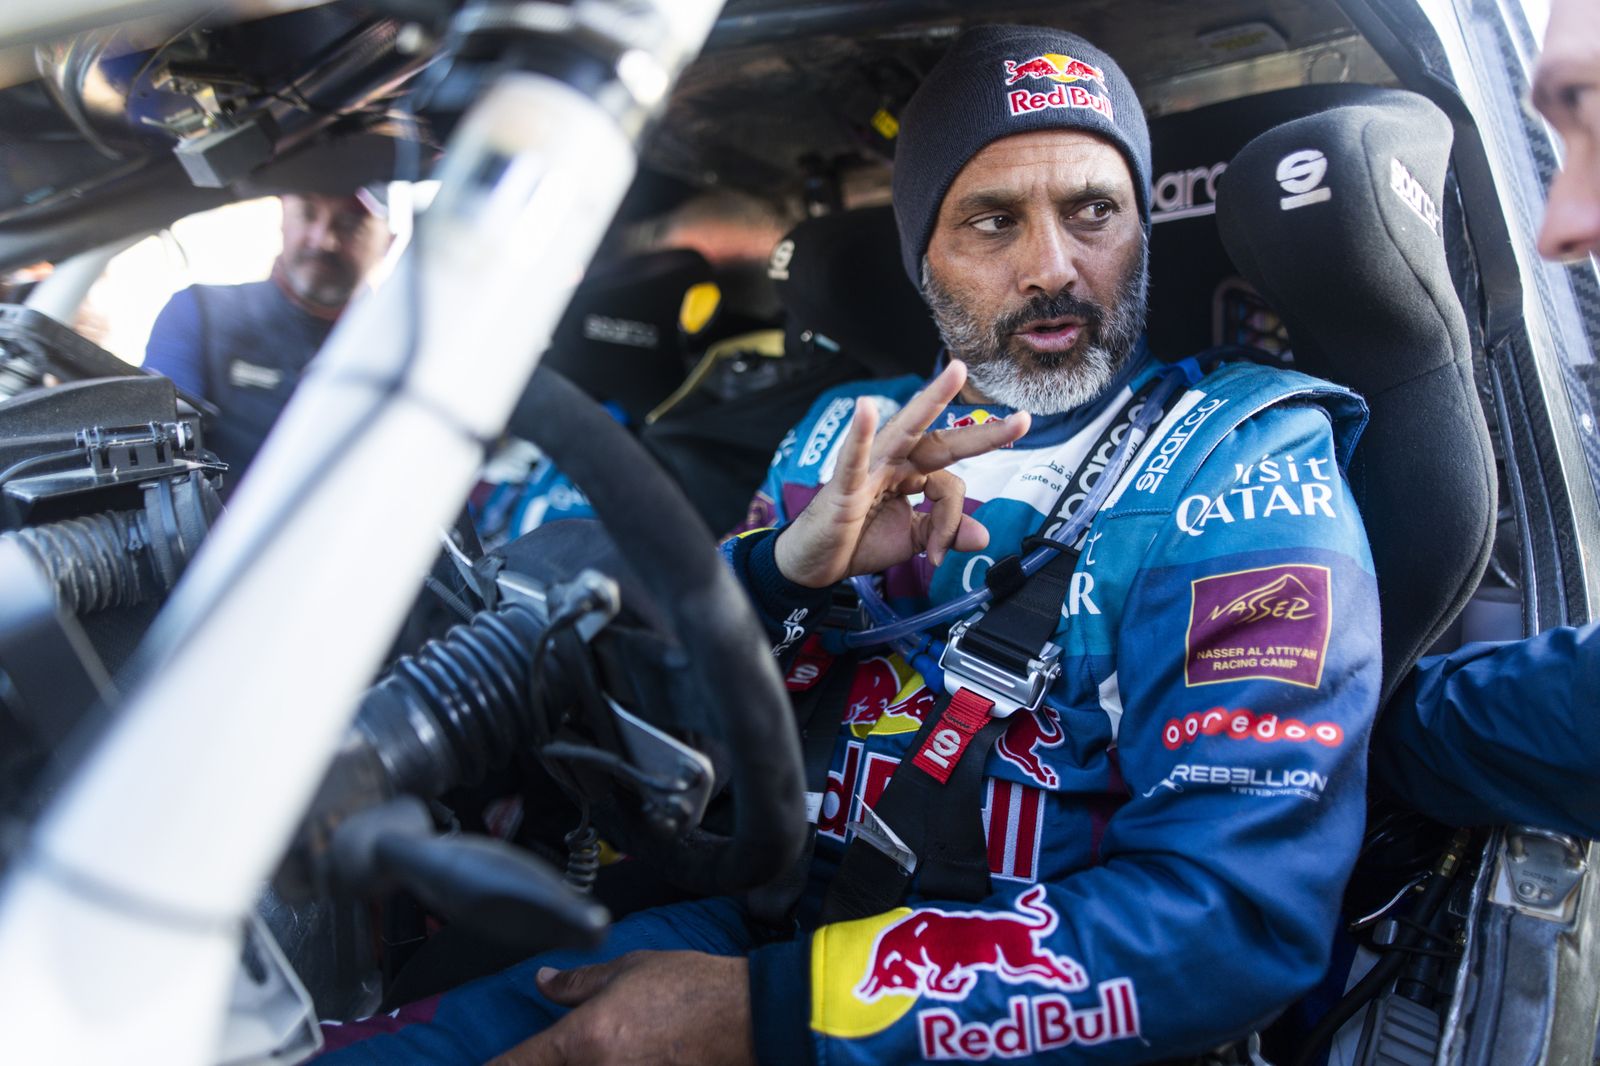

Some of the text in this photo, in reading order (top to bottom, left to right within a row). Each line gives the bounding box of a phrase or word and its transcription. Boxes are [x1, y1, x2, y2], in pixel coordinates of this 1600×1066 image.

[1009, 84, 1114, 122] Red Bull
[1136, 399, 1229, 494] sparco
[1050, 482, 1063, 493] of
[1176, 483, 1337, 536] QATAR
[1197, 647, 1245, 660] NASSER
[1248, 647, 1263, 657] AL
[1213, 658, 1298, 671] RACING CAMP
[1164, 709, 1340, 746] ooredoo
[919, 978, 1139, 1060] Red Bull
